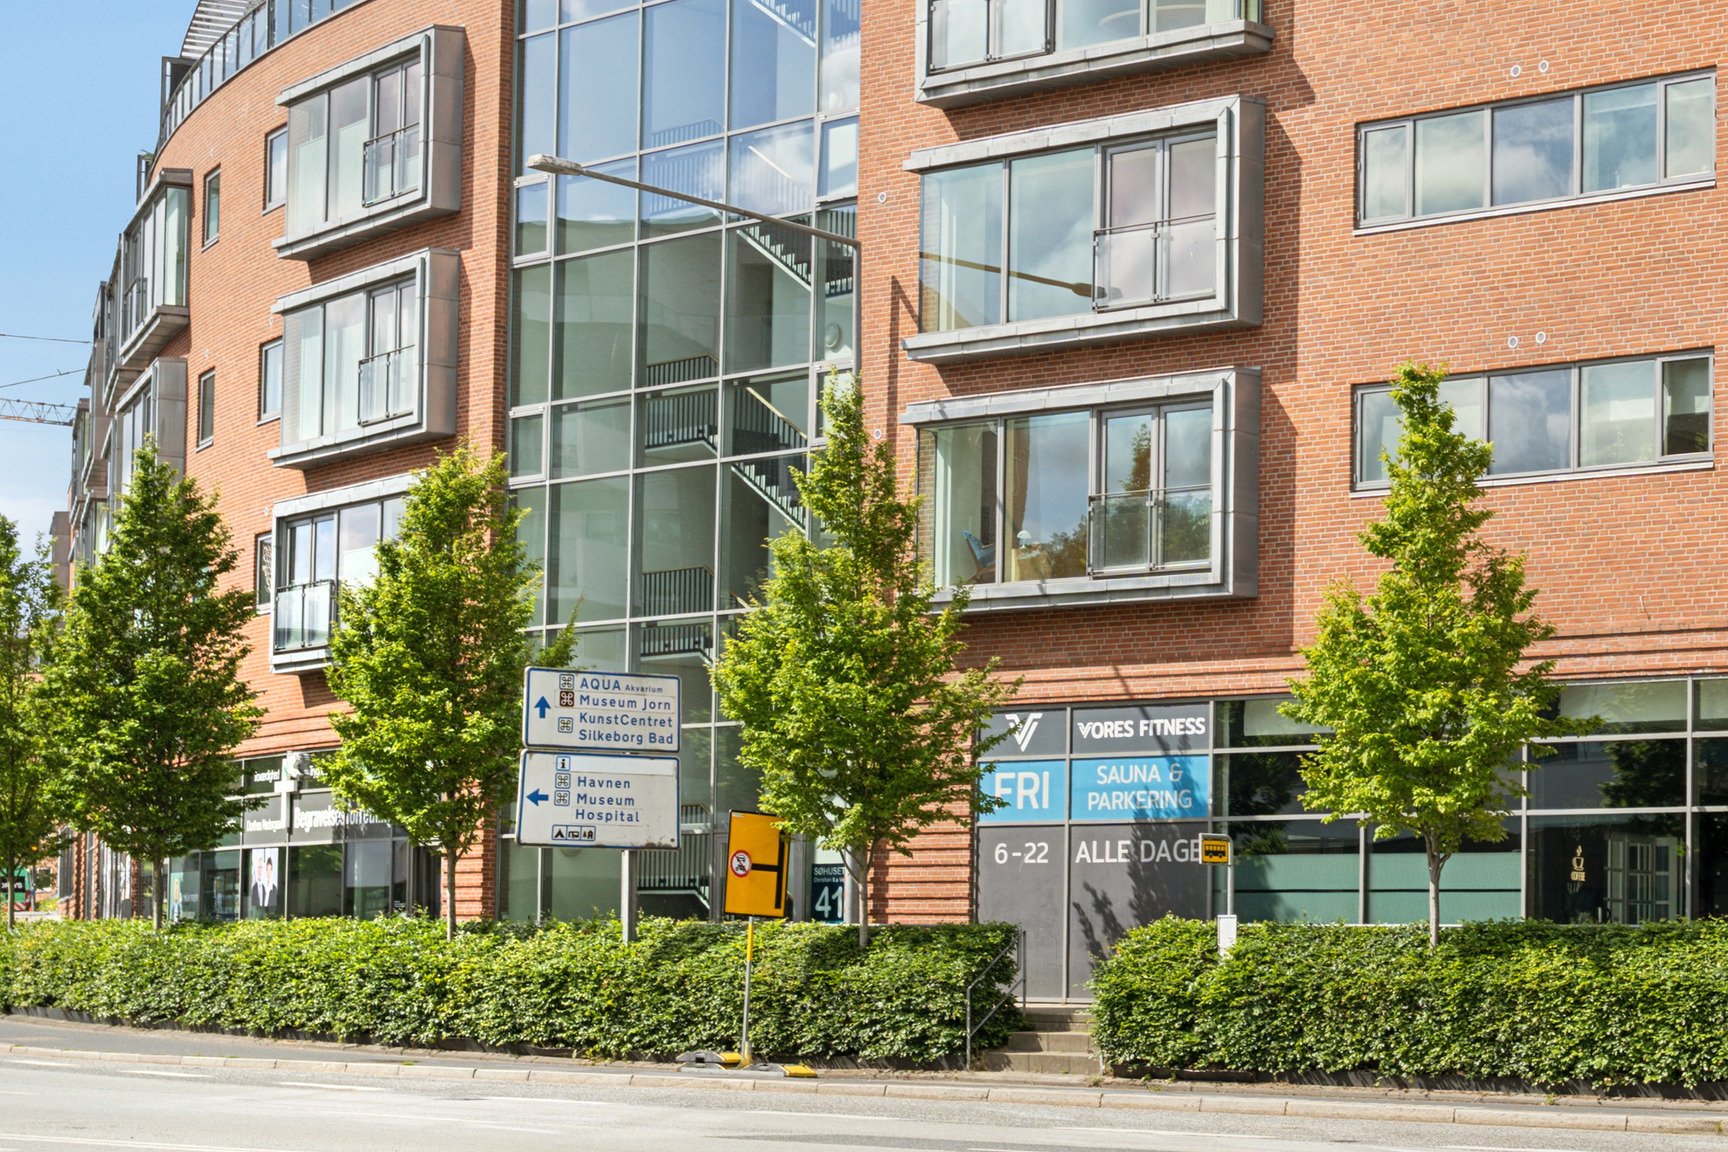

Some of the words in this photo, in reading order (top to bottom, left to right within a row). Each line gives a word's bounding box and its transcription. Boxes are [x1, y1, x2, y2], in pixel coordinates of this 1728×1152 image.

[580, 677, 621, 691] AQUA
[624, 684, 664, 694] Akvarium
[579, 694, 637, 709] Museum
[642, 698, 671, 711] Jorn
[579, 712, 673, 728] KunstCentret
[1077, 720, 1135, 739] VORES
[1139, 717, 1206, 737] FITNESS
[578, 729, 644, 745] Silkeborg
[648, 732, 673, 745] Bad
[1096, 764, 1161, 785] SAUNA
[1168, 762, 1184, 784] &
[577, 776, 631, 789] Havnen
[994, 771, 1050, 810] FRI
[576, 793, 635, 806] Museum
[1088, 788, 1193, 811] PARKERING
[575, 808, 640, 823] Hospital
[1075, 840, 1131, 864] ALLE
[1140, 838, 1201, 863] DAGE
[815, 886, 843, 918] 41
